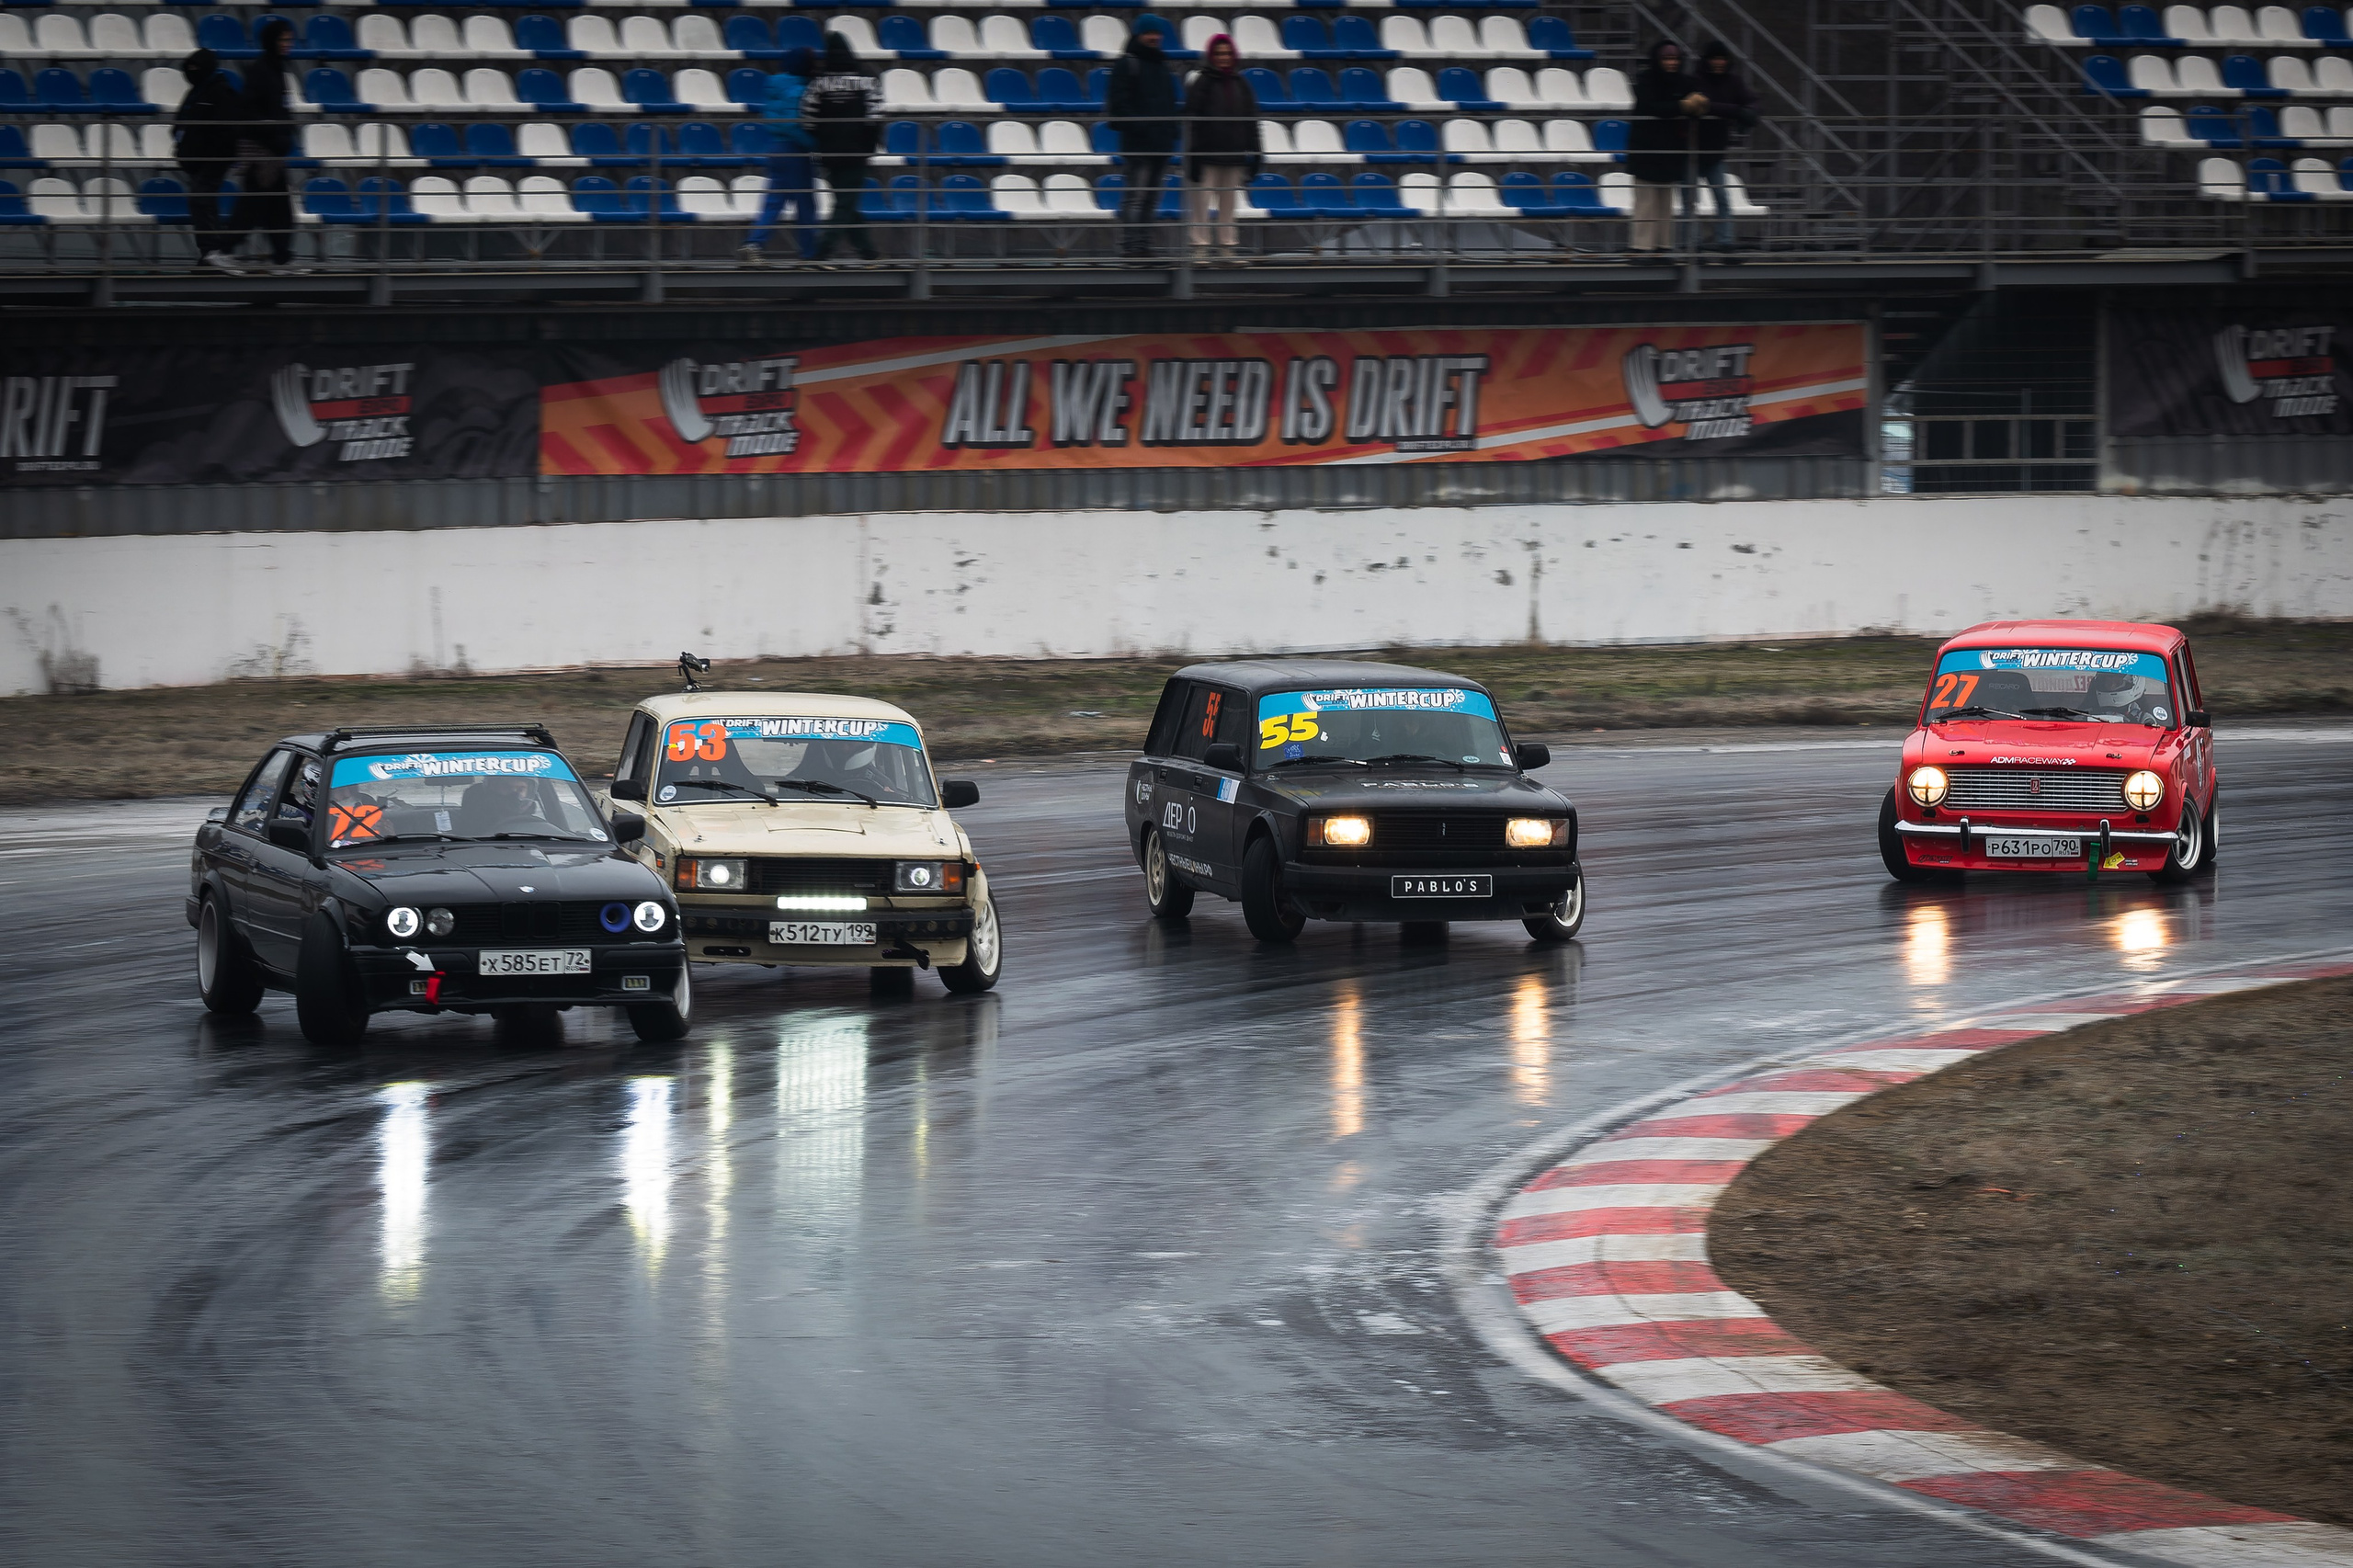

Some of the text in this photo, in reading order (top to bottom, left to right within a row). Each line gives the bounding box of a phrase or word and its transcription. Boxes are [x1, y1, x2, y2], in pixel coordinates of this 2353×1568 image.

[699, 358, 799, 395] DRIFT
[1659, 346, 1754, 381] DRIFT
[311, 363, 415, 400] DRIFT
[0, 375, 119, 458] RIFT
[943, 354, 1489, 447] ALL WE NEED IS DRIFT
[1993, 652, 2023, 660] DRIFT
[1315, 694, 1348, 703] DRIFT
[1930, 674, 1980, 710] 27
[668, 723, 726, 762] 53
[1260, 710, 1319, 749] 55
[2053, 839, 2076, 851] 790
[1404, 878, 1477, 892] PABLO'S
[847, 924, 872, 937] 199
[565, 951, 585, 966] 72
